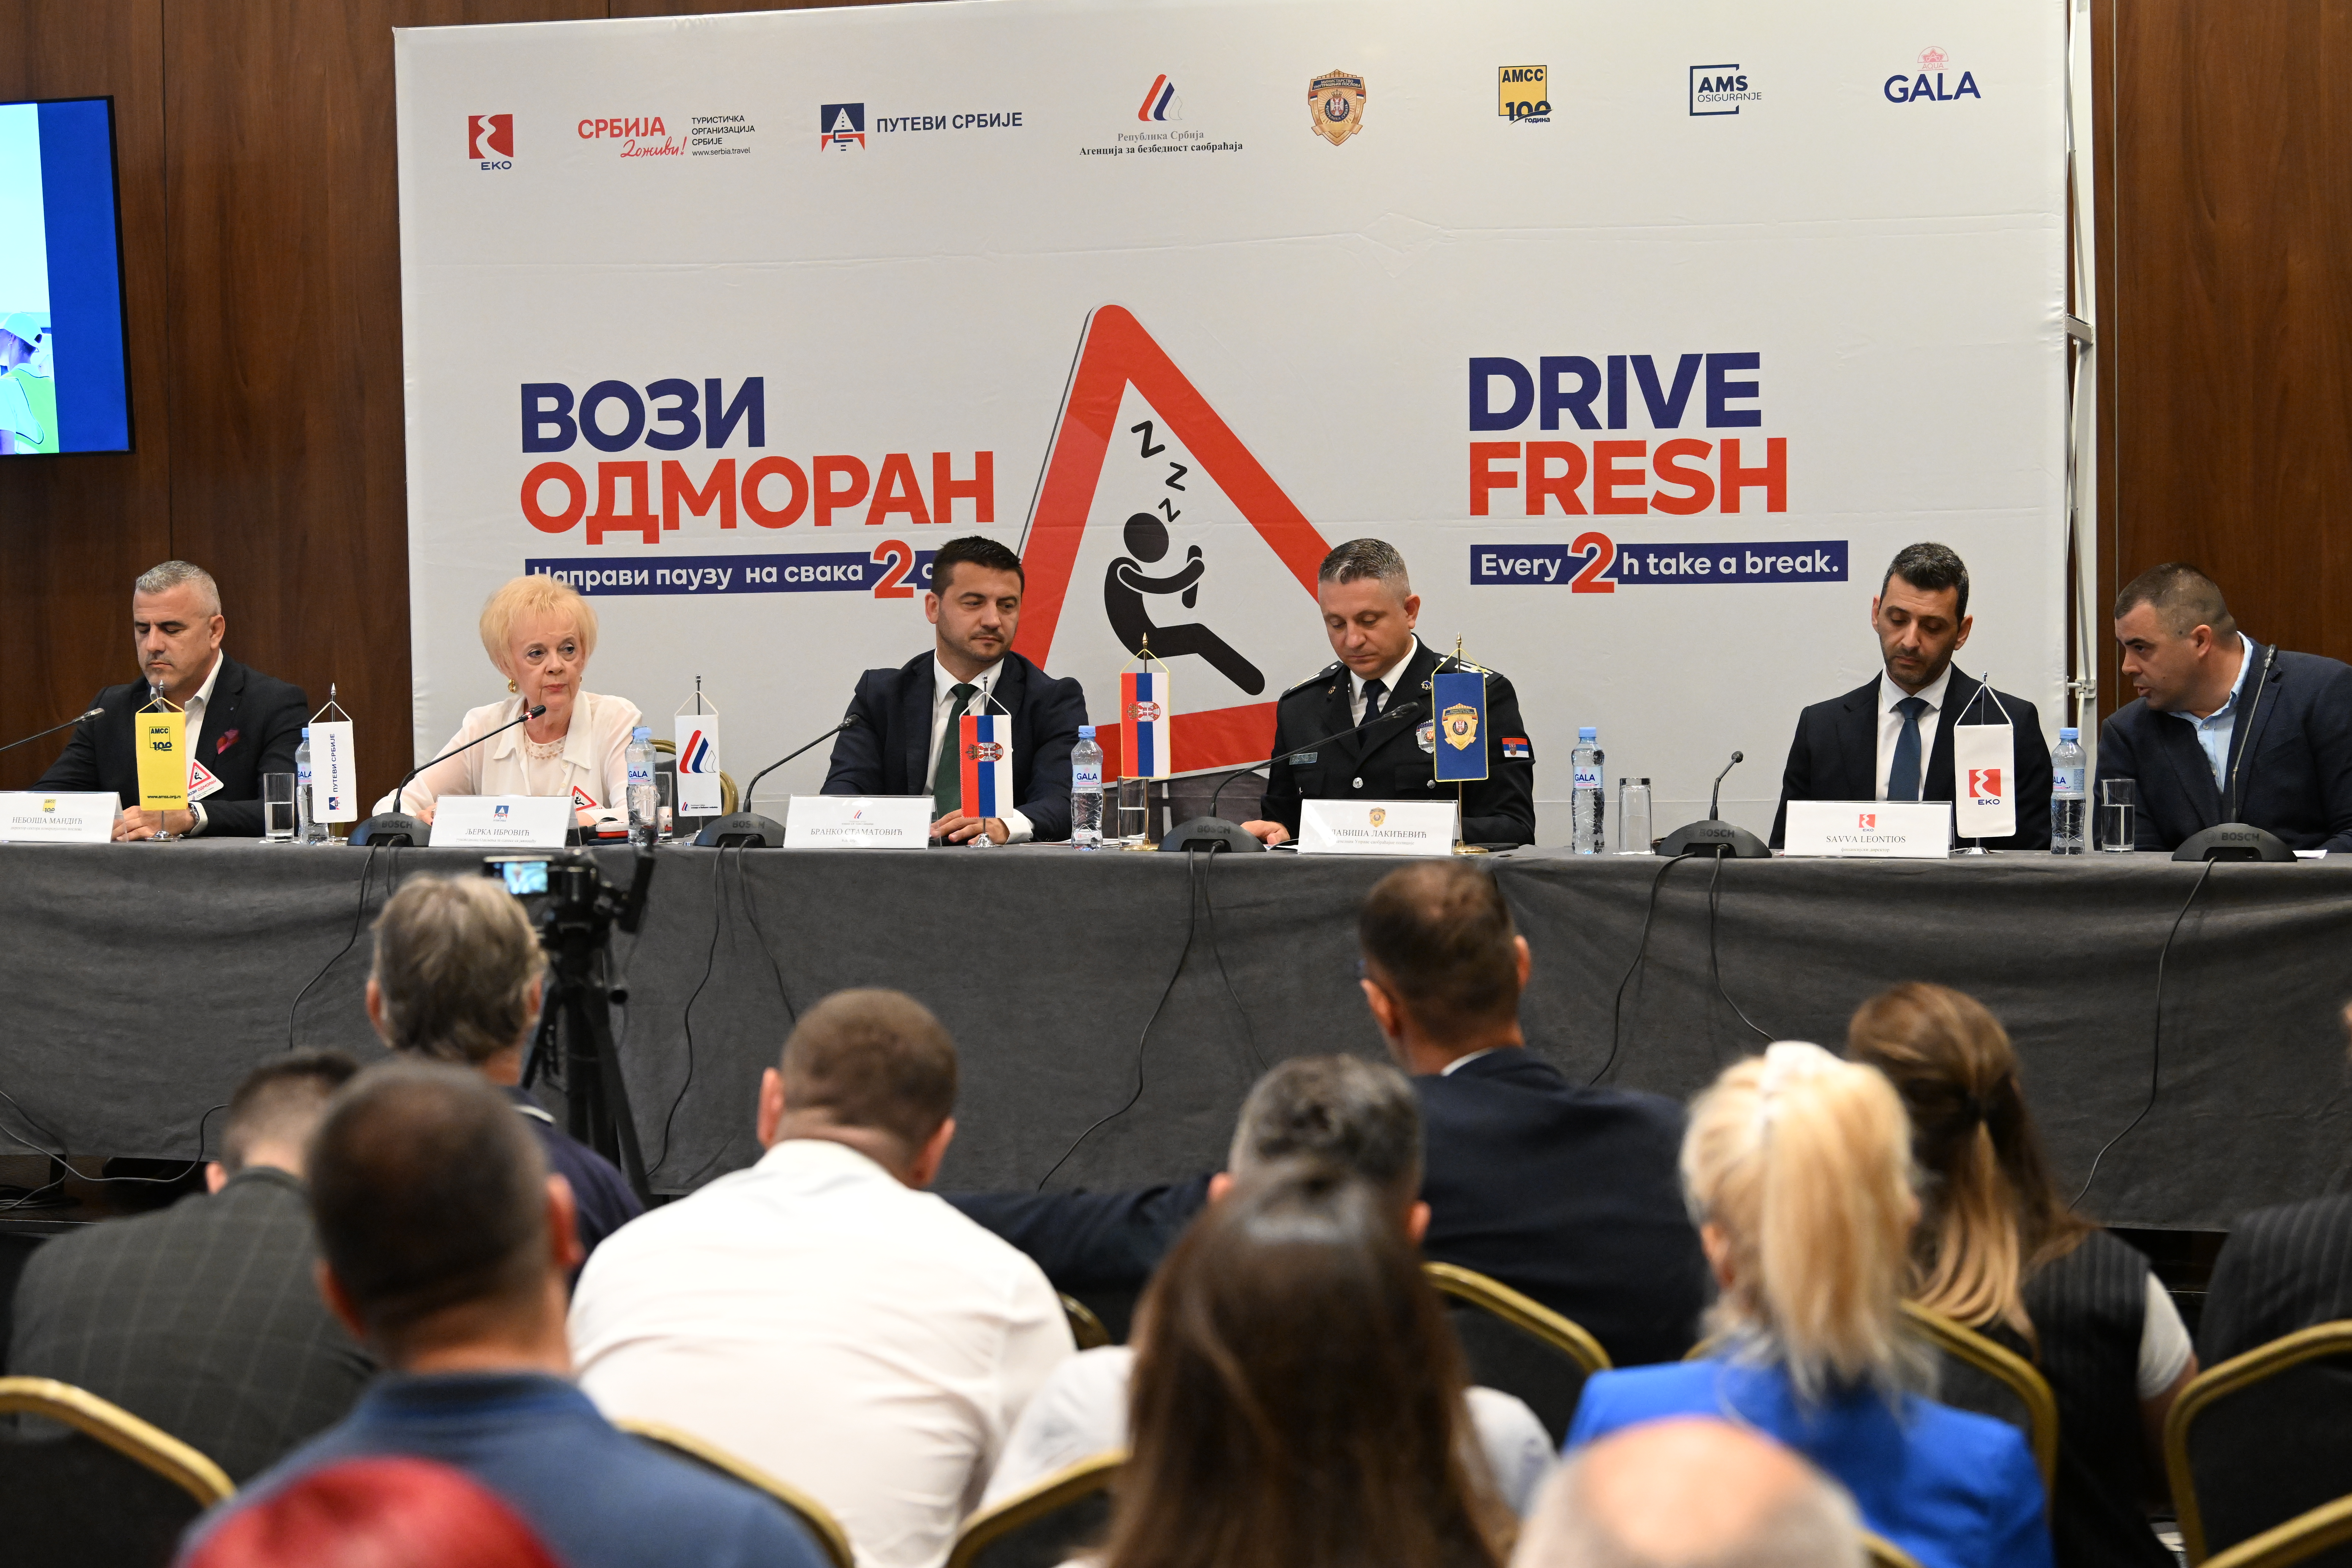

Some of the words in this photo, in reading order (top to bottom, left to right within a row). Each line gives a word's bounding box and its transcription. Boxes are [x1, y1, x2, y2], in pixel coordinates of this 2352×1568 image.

[1502, 69, 1544, 82] АМСС
[1698, 76, 1748, 93] AMS
[1884, 71, 1981, 103] GALA
[1698, 92, 1762, 102] OSIGURANJE
[1325, 105, 1341, 121] РЕПУБЛИКА
[1505, 100, 1551, 121] 100
[692, 115, 744, 124] ТУРИСТИЧКА
[877, 116, 945, 132] ПУТЕВИ
[953, 112, 1022, 129] СРБИЈЕ
[578, 117, 665, 139] СРБИЈА
[692, 125, 755, 135] ОРГАНИЗАЦИЈА
[1118, 133, 1167, 142] Република
[1171, 131, 1203, 141] Србија
[692, 147, 750, 155] www.serbia.travel
[1080, 146, 1122, 156] Агенција
[1191, 142, 1242, 153] саобраћаја
[481, 161, 512, 170] EKO
[1469, 352, 1761, 431] DRIVE
[521, 377, 765, 453] ВОЗИ
[1470, 438, 1786, 515] FRESH
[521, 451, 994, 545] ОДМОРАН
[656, 567, 733, 591] паузу
[746, 567, 777, 583] на
[784, 565, 863, 582] свака
[873, 539, 914, 598] 2
[1481, 553, 1561, 581] Every
[1571, 532, 1615, 593] 2
[1623, 552, 1639, 575] h
[1647, 552, 1711, 575] take
[1719, 557, 1737, 574] a
[1746, 550, 1839, 574] break.
[198, 779, 216, 791] ОДМОРАН
[382, 820, 413, 829] BOSCH
[1197, 825, 1230, 834] BOSCH
[1699, 829, 1735, 838] BOSCH
[2221, 832, 2259, 841] BOSCH
